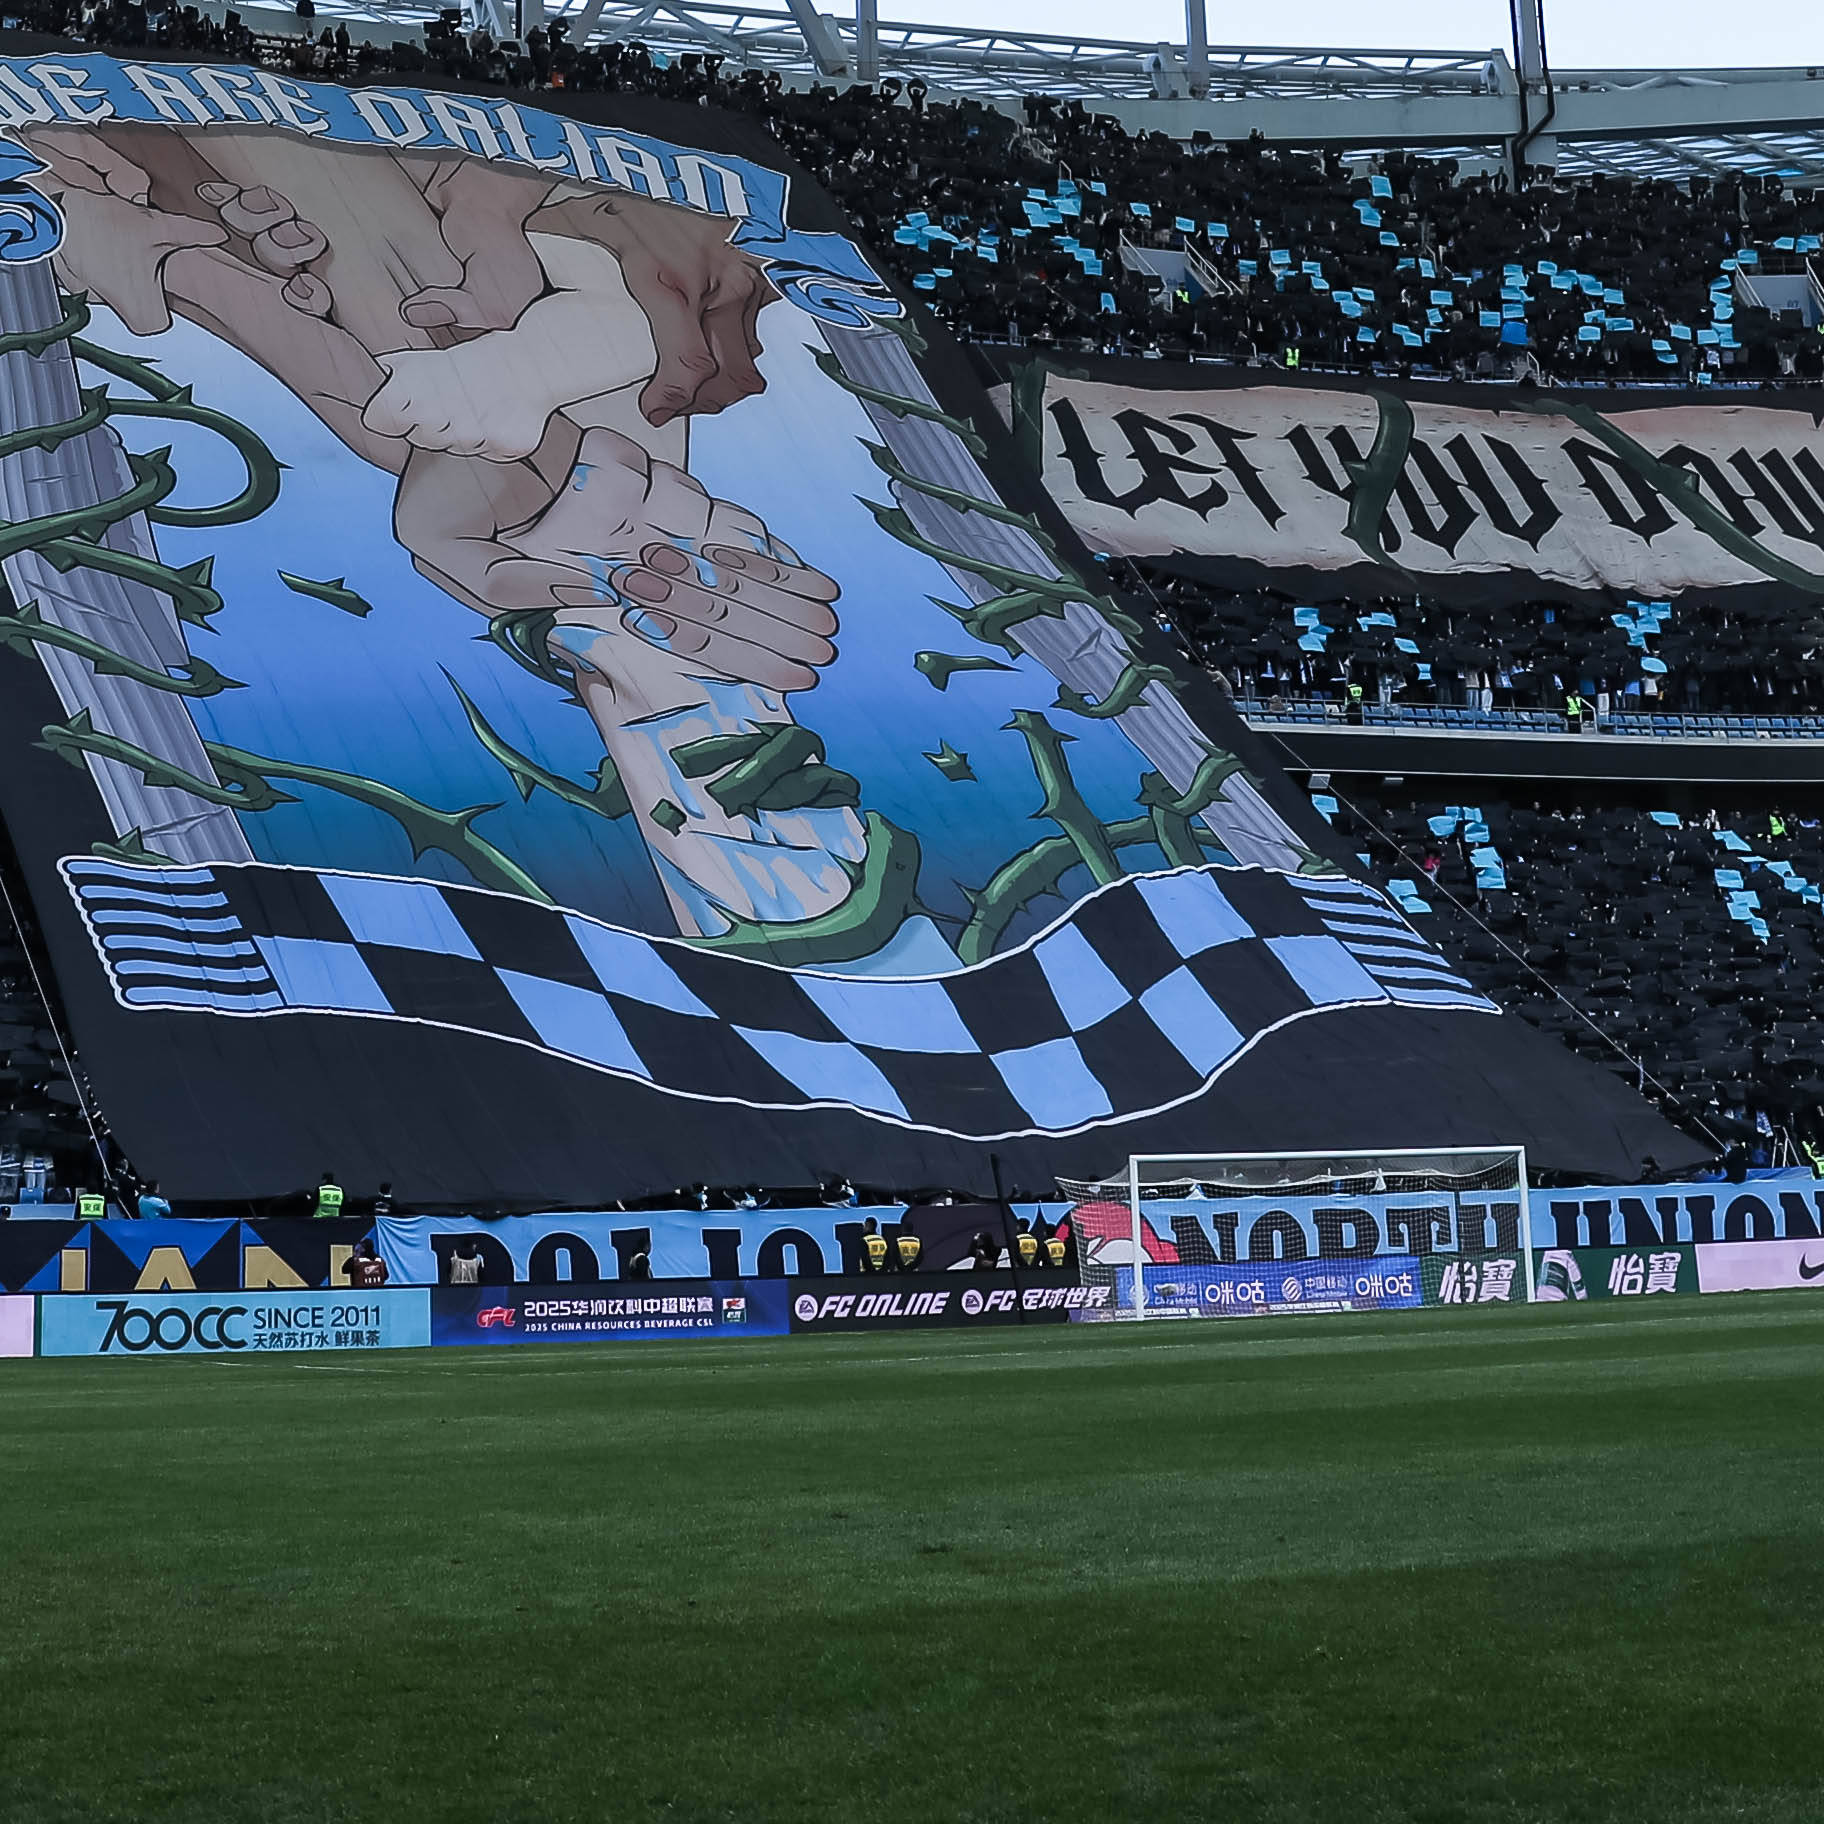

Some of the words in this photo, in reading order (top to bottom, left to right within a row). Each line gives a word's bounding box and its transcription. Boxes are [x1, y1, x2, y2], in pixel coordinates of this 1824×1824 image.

[121, 62, 329, 138] ARE
[348, 86, 751, 219] DALIAN
[1047, 396, 1288, 533] LET
[1288, 420, 1564, 558] YOU
[1170, 1202, 1520, 1264] NORTH
[1355, 1272, 1412, 1298] 咪咕
[1608, 1252, 1681, 1296] 怡寶
[817, 1293, 855, 1319] FC
[855, 1291, 950, 1317] ONLINE
[983, 1289, 1017, 1312] FC
[1022, 1286, 1111, 1310] 足球世界
[1205, 1279, 1265, 1305] 咪咕
[95, 1301, 248, 1352] 700CC
[253, 1306, 324, 1330] SINCE
[330, 1305, 381, 1329] 2011
[525, 1323, 548, 1333] 2025
[551, 1321, 581, 1332] CHINA
[584, 1320, 642, 1331] RESOURCES
[644, 1319, 694, 1329] BEVERAGE
[696, 1318, 713, 1327] CSL
[253, 1332, 329, 1349] 天然苏打水
[335, 1330, 380, 1348] 鲜果茶
